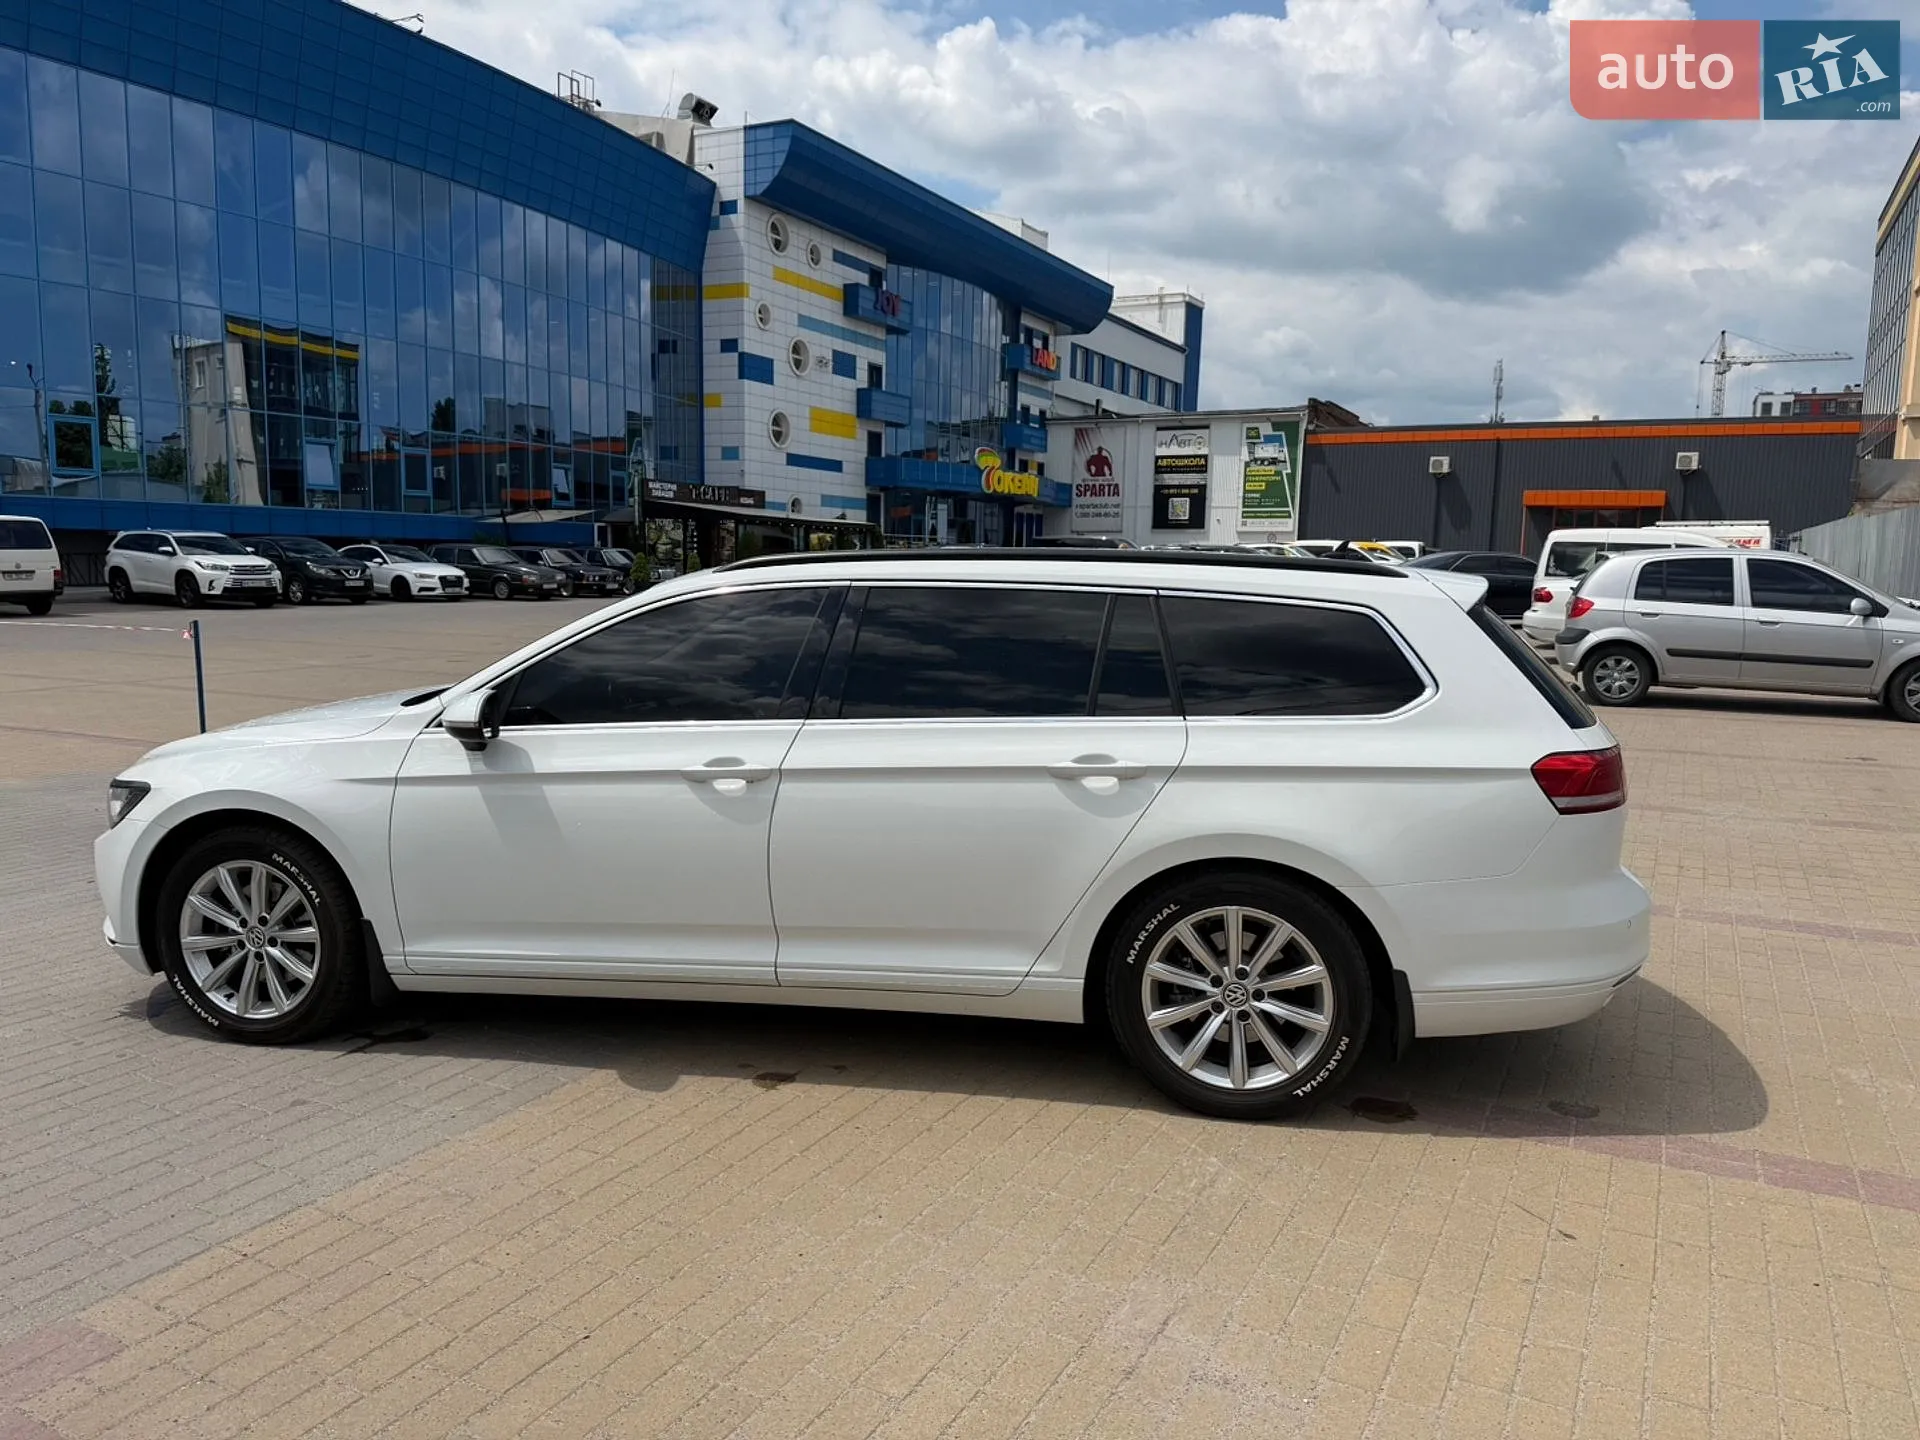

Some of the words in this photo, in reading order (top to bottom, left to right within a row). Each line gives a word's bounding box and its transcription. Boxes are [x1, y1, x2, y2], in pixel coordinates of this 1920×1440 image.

[873, 287, 901, 317] JOY
[1032, 347, 1058, 372] LAND
[1157, 458, 1206, 468] АВТОШКОЛА
[1075, 483, 1120, 498] SPARTA
[1126, 903, 1180, 964] MARSHAL
[1292, 1036, 1350, 1097] MARSHAL
